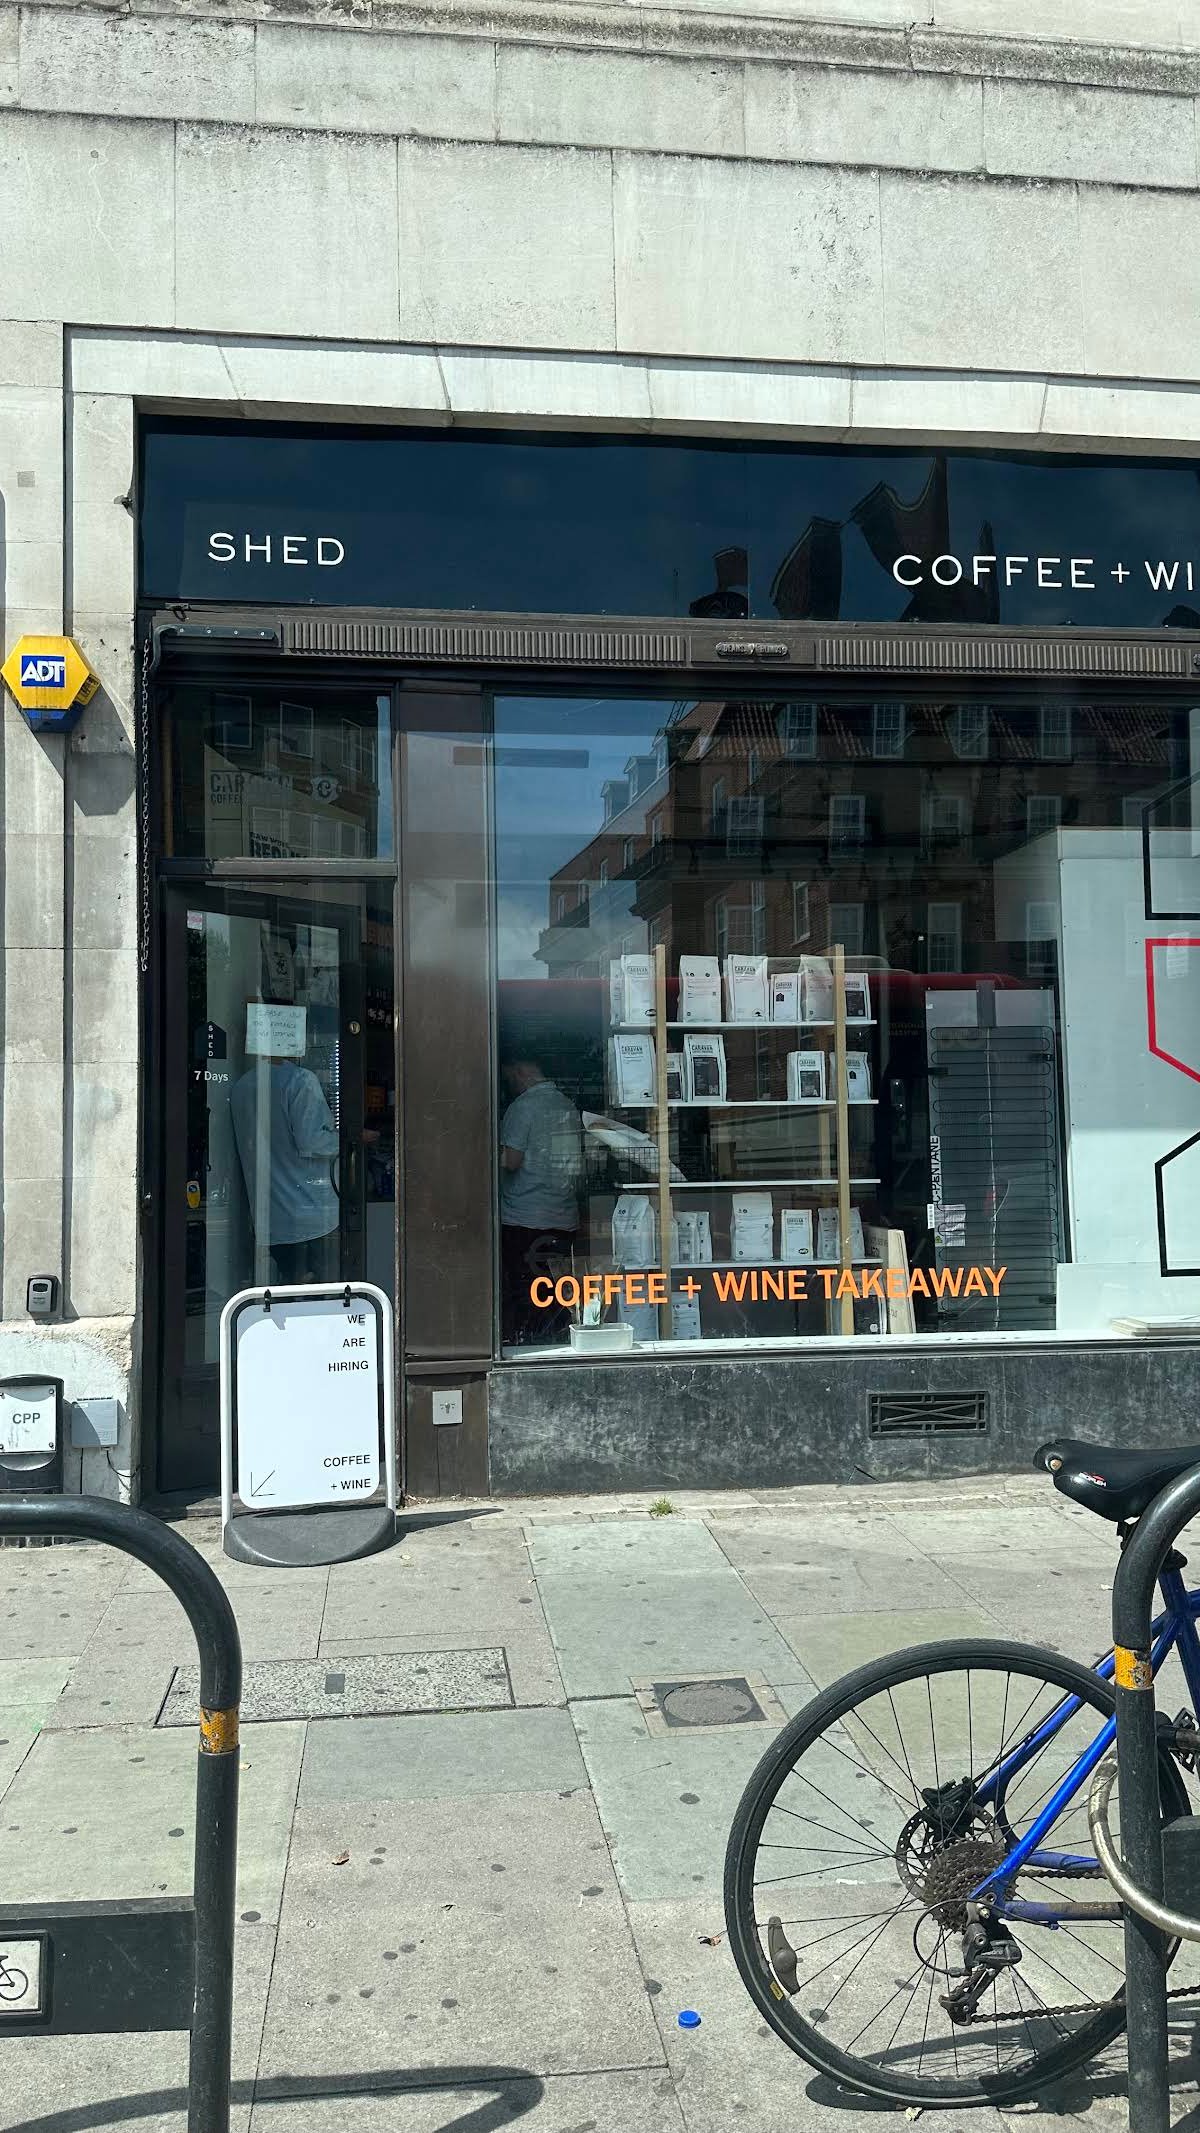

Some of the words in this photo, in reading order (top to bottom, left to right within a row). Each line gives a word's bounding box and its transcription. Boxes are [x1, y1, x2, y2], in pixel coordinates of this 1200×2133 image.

[207, 532, 345, 566] SHED
[892, 554, 1095, 589] COFFEE
[1110, 562, 1130, 584] +
[1144, 561, 1194, 591] WI
[21, 660, 63, 683] ADT
[193, 1070, 202, 1081] 7
[204, 1070, 229, 1083] Days
[530, 1273, 667, 1307] COFFEE
[680, 1276, 702, 1300] +
[713, 1270, 805, 1301] WINE
[817, 1266, 1007, 1299] TAKEAWAY
[347, 1313, 366, 1324] WE
[342, 1337, 366, 1348] ARE
[328, 1360, 369, 1372] HIRING
[12, 1411, 41, 1425] CPP
[323, 1454, 371, 1468] COFFEE
[340, 1479, 371, 1490] WINE
